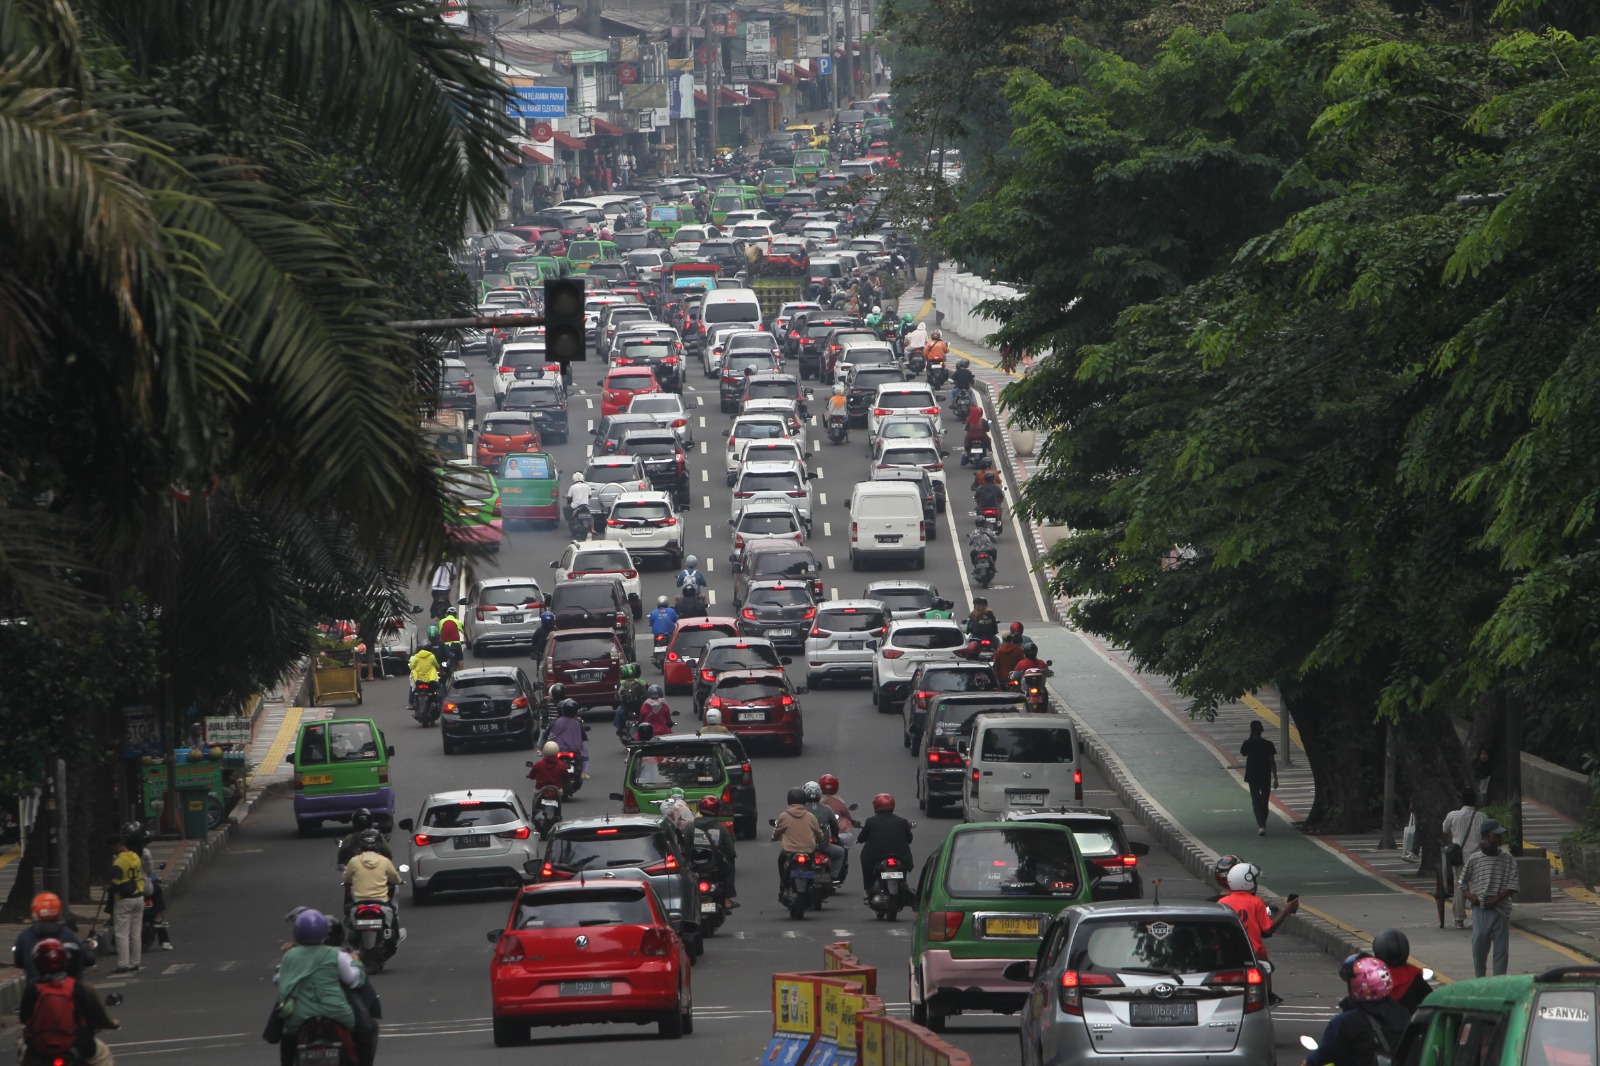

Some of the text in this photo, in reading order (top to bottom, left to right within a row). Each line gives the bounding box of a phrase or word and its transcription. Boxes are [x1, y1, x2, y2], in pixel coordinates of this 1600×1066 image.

[820, 58, 829, 73] P
[560, 983, 566, 991] F
[575, 981, 594, 991] 1520
[1132, 1005, 1139, 1016] F
[1150, 1005, 1172, 1016] 1066
